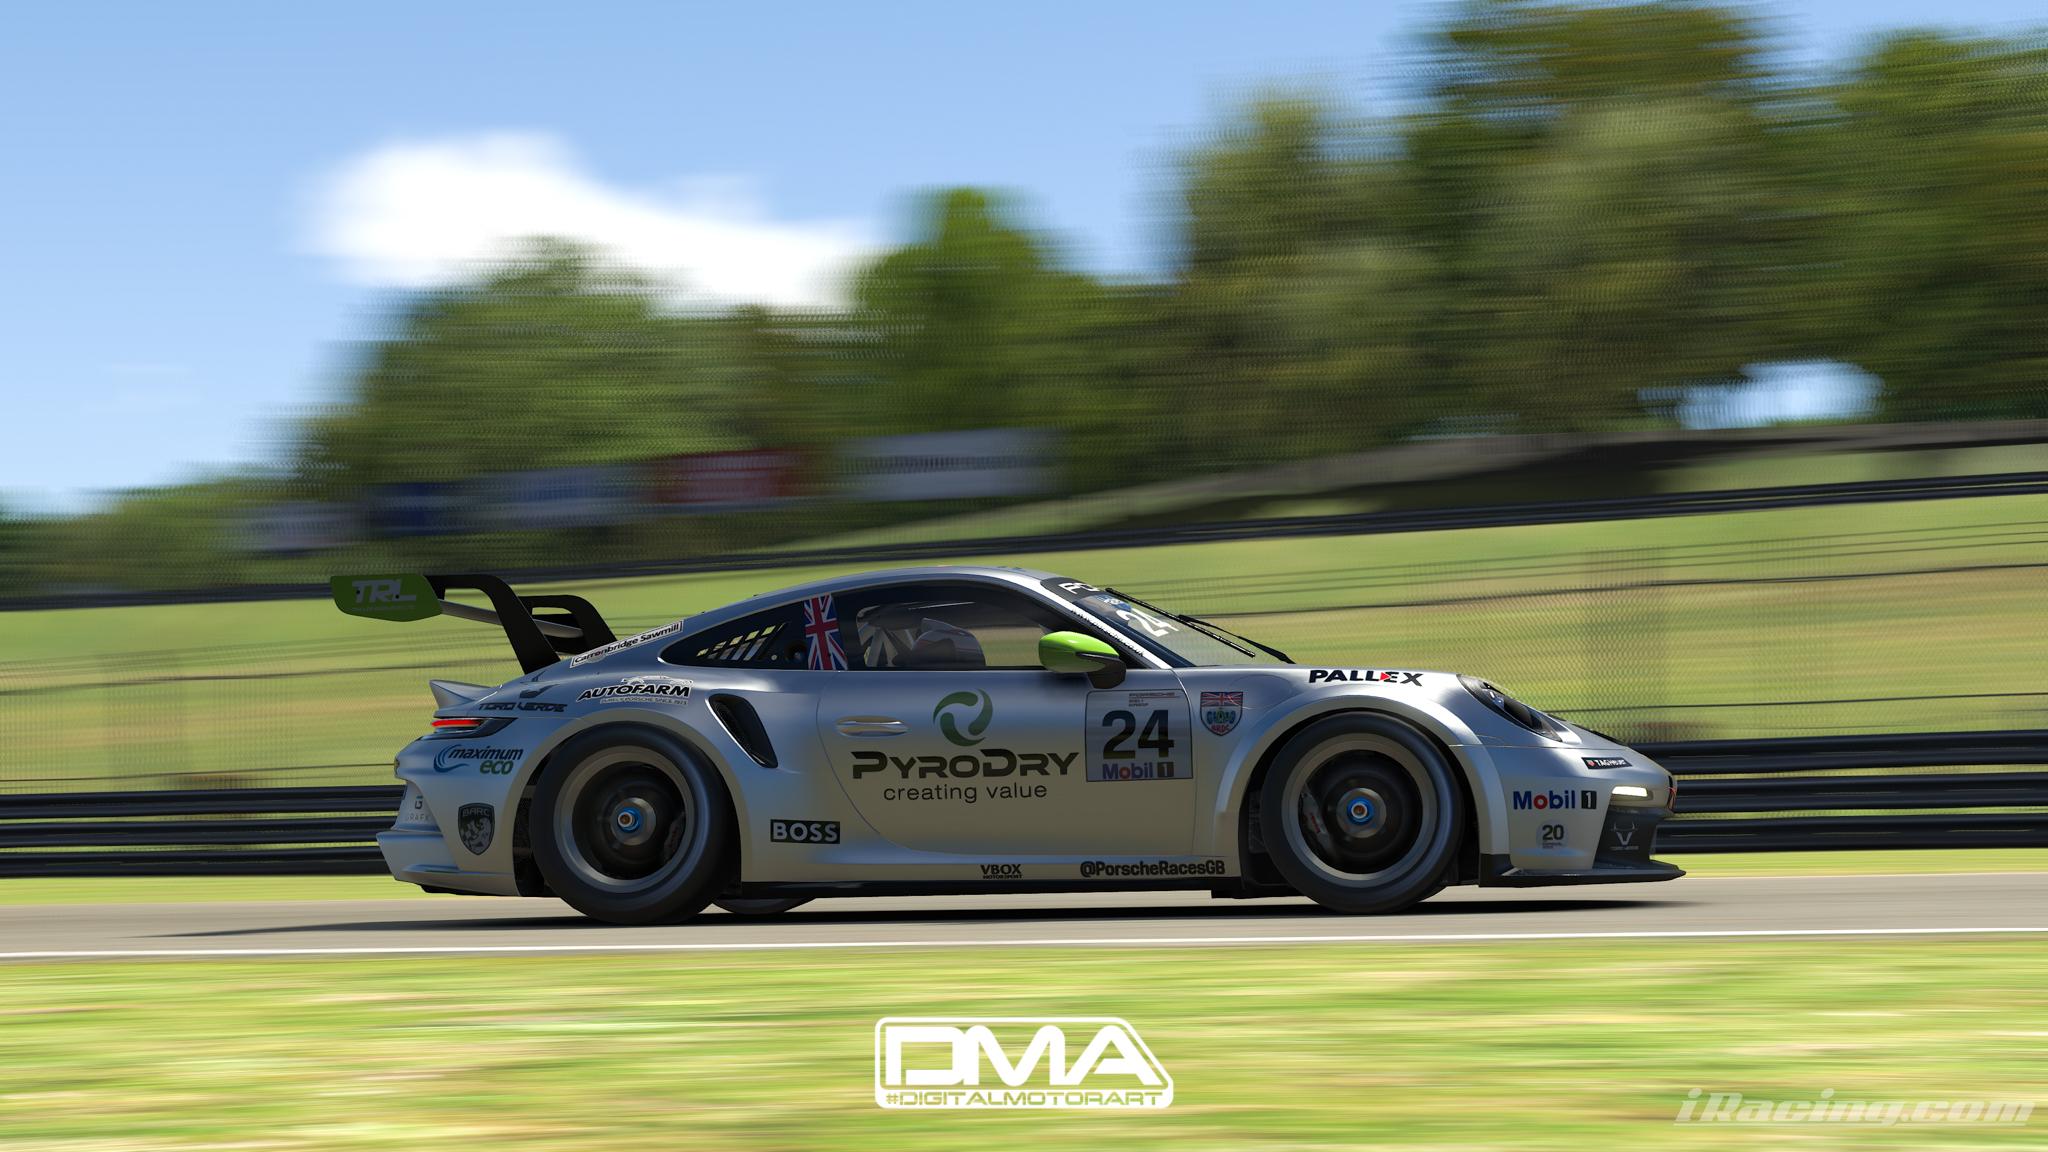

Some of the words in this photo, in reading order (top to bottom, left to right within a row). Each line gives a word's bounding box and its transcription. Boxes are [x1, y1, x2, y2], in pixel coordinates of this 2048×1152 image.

[351, 579, 417, 603] TRL
[1115, 607, 1180, 637] 24
[640, 623, 680, 642] Sawmill
[1308, 669, 1425, 687] PALLEX
[576, 684, 691, 701] AUTOFARM
[1101, 709, 1175, 760] 24
[447, 745, 524, 760] maximum
[479, 760, 514, 775] eco
[1102, 762, 1154, 780] Mobil
[883, 784, 978, 804] creating
[986, 782, 1048, 799] value
[1513, 790, 1576, 810] Mobil
[773, 821, 838, 842] BOSS
[1542, 824, 1565, 841] 20
[980, 863, 1022, 875] VBOX
[1080, 860, 1225, 878] @PorscheRacesGB
